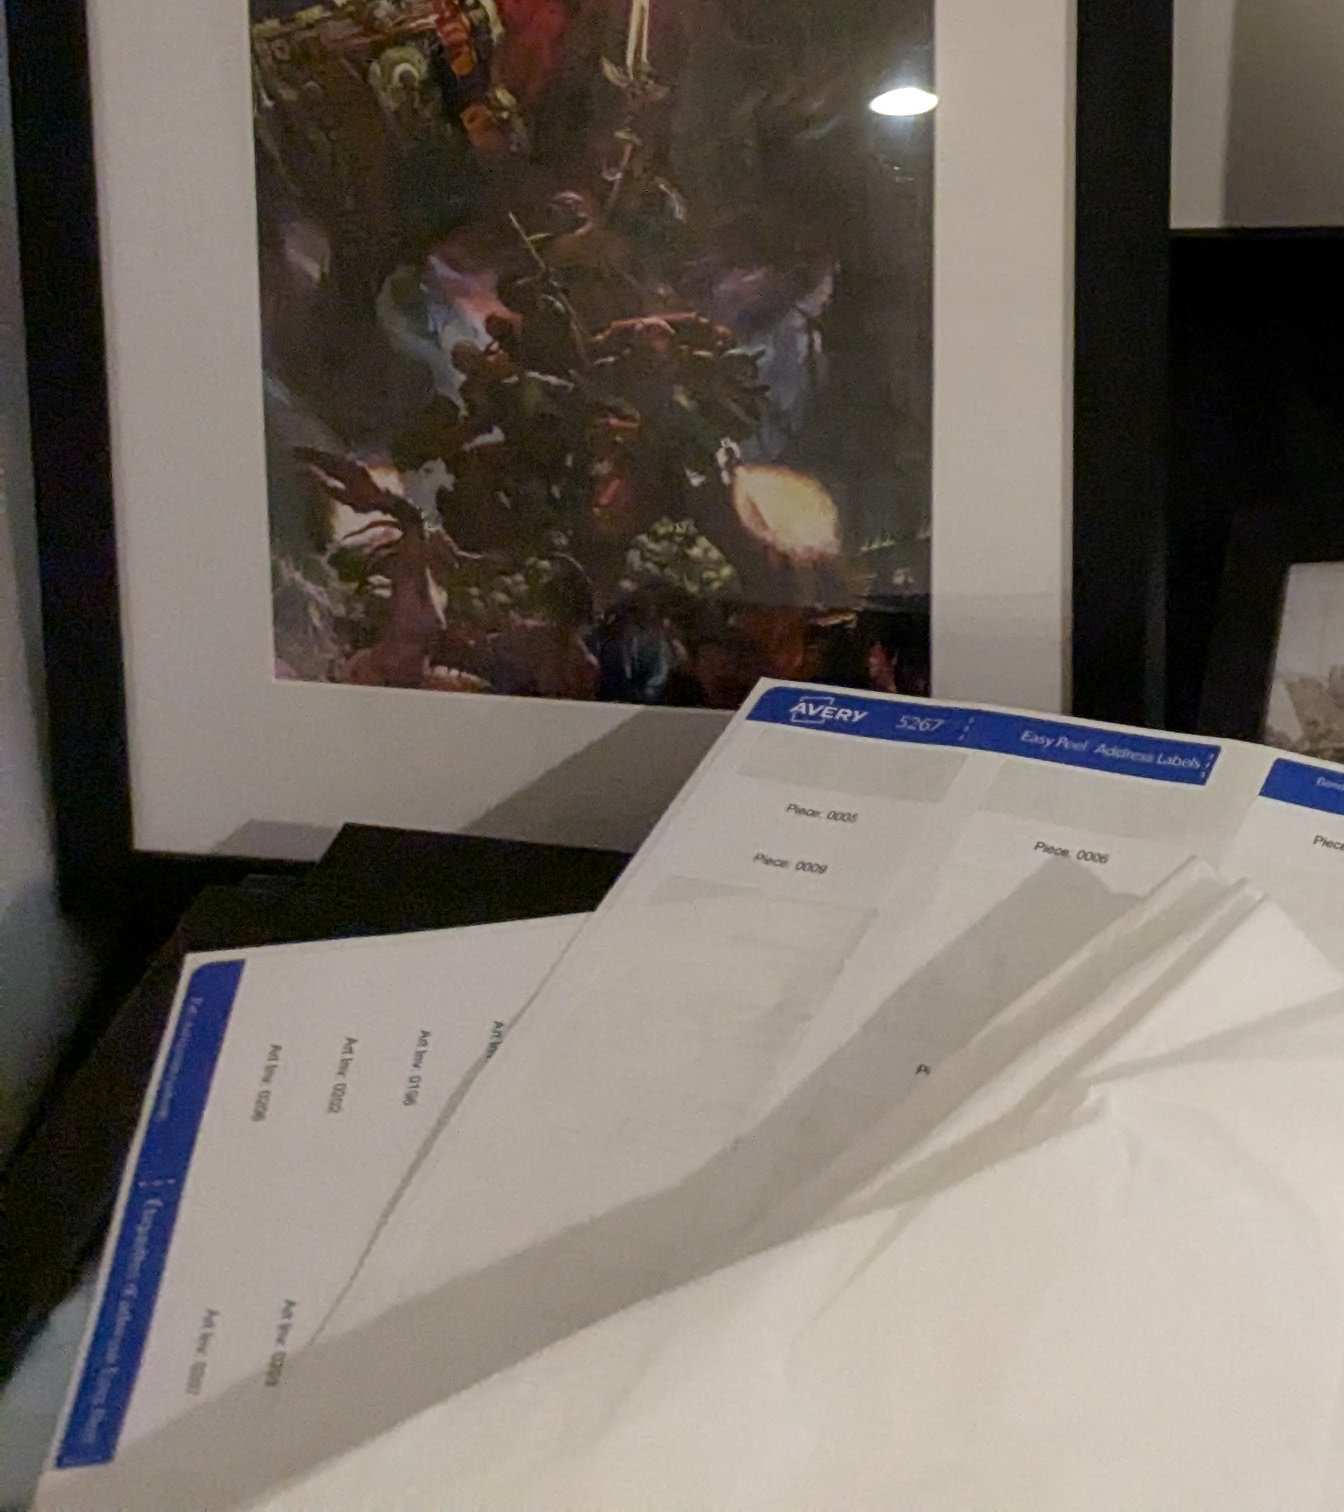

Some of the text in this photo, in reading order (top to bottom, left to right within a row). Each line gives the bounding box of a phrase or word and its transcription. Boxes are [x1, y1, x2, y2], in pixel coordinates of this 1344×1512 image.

[789, 701, 945, 732] AVERY 5267
[1020, 730, 1201, 770] Easy Peel Address Labels
[794, 860, 829, 876] 0009
[1076, 848, 1110, 865] 0006
